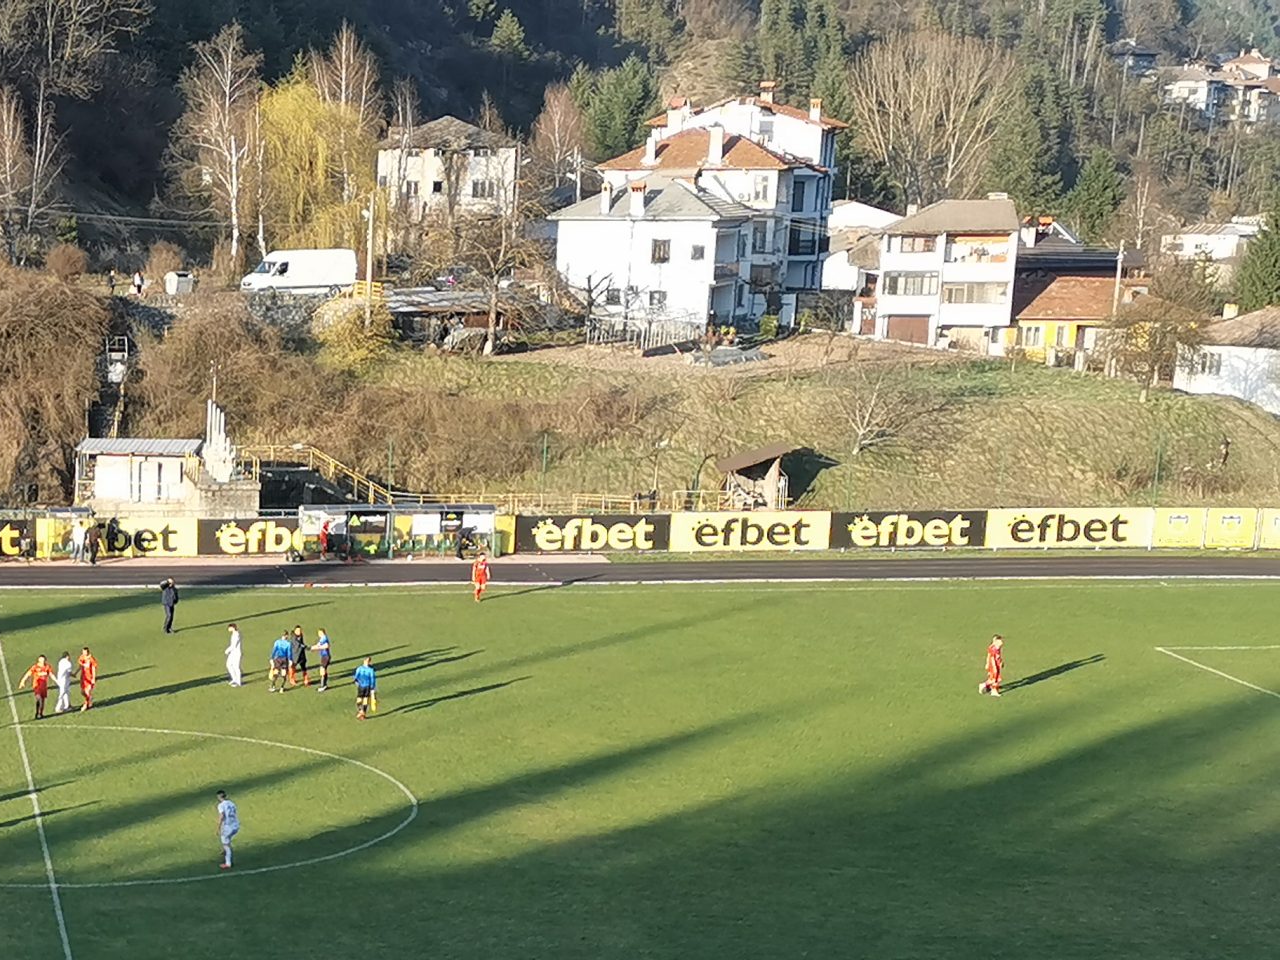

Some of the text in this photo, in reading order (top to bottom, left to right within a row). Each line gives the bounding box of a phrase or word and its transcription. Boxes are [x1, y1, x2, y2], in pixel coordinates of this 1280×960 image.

[535, 517, 654, 549] efbet
[695, 517, 810, 546] efbet
[851, 514, 970, 546] efbet
[1011, 514, 1128, 542] efbet
